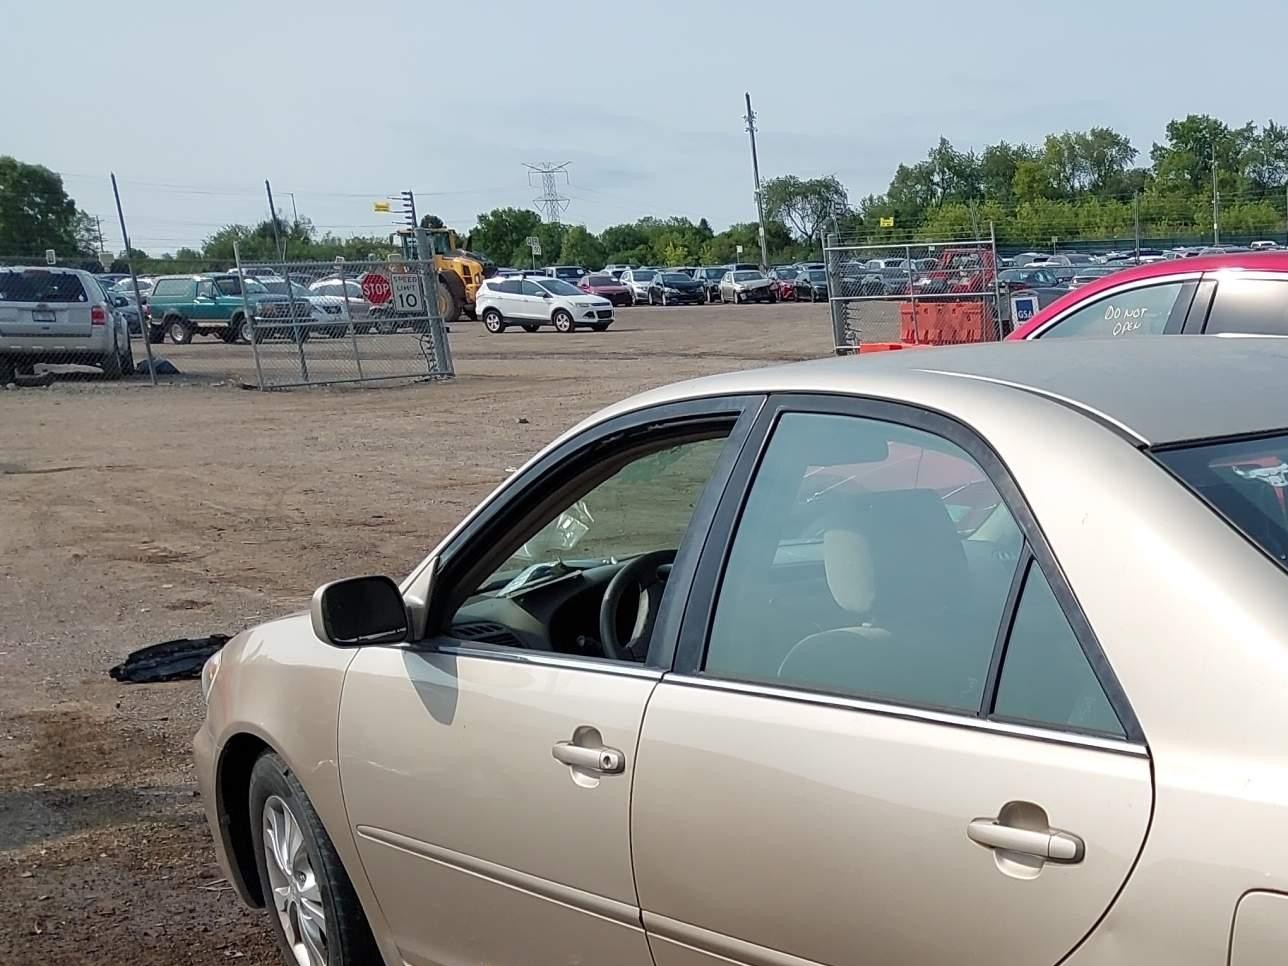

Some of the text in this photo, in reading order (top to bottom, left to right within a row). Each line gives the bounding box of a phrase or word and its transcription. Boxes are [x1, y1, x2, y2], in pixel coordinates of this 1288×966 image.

[362, 283, 390, 296] STOP
[399, 294, 418, 308] 10
[1017, 310, 1033, 319] GSA
[1104, 304, 1149, 320] DO NOT
[1112, 321, 1142, 336] OPEN
